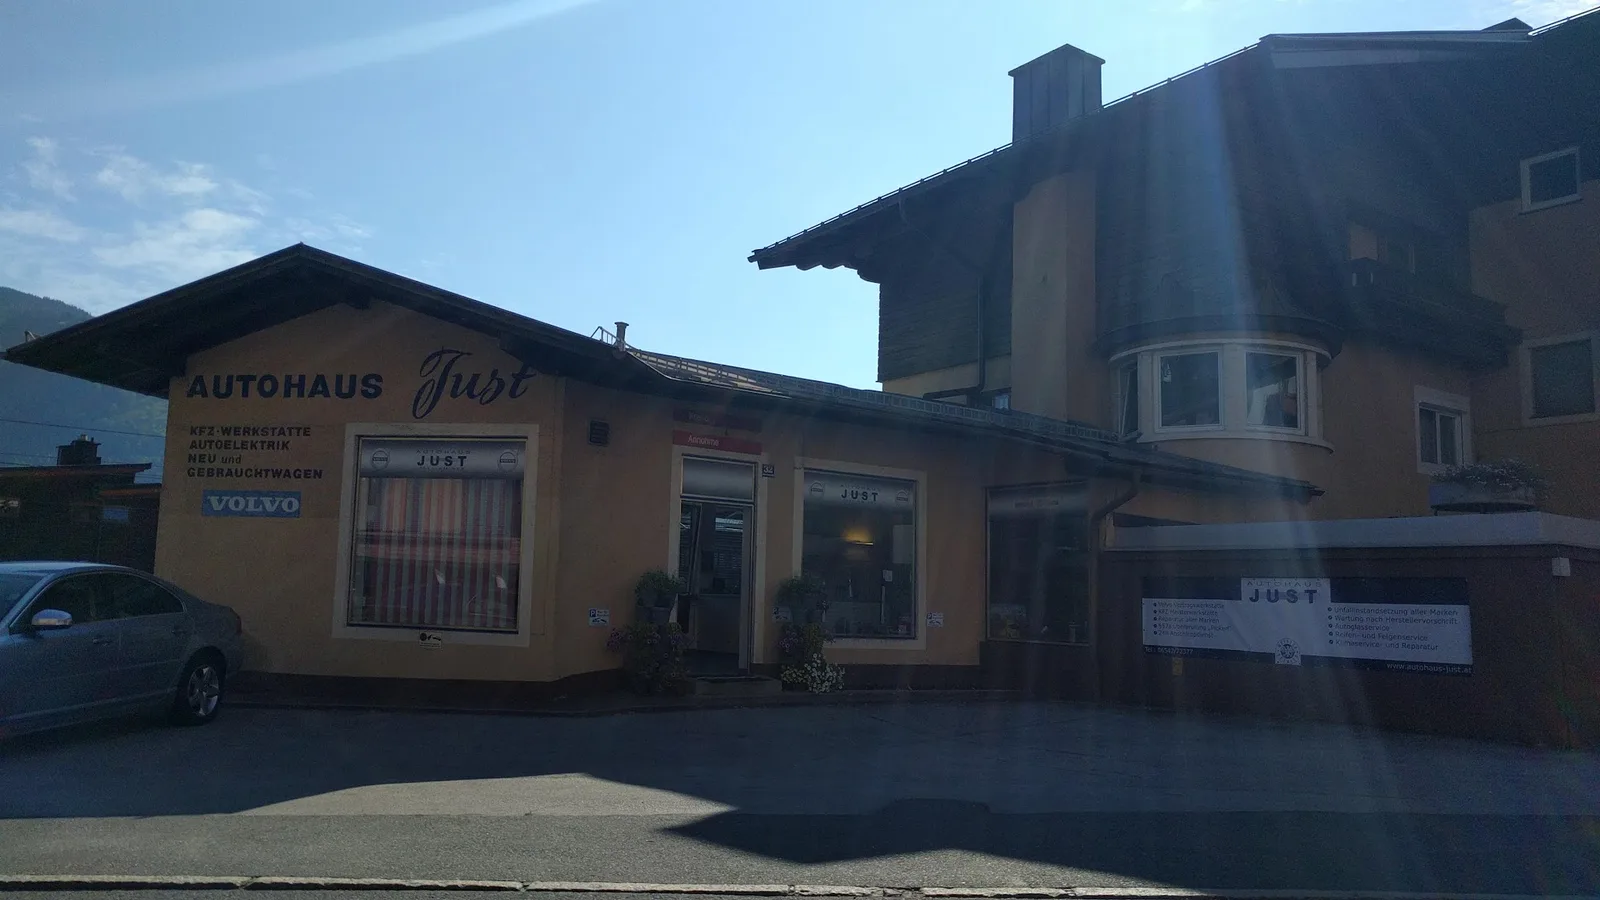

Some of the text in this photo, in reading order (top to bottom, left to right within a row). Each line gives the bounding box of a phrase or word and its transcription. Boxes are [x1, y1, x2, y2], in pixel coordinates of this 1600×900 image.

[186, 346, 536, 419] AUTOHAUS Just
[189, 439, 291, 450] AUTOELEKTRIK
[187, 453, 242, 464] NEU und
[417, 455, 467, 467] JUST
[187, 467, 323, 480] GEBRAUCHTWAGEN
[763, 465, 773, 474] 32
[841, 489, 879, 502] JUST
[207, 495, 300, 512] VOLVO
[1249, 588, 1317, 604] JUST
[1334, 607, 1458, 617] Unfallinstandsetzung aller Marken
[1335, 615, 1364, 623] Wartung
[1335, 623, 1390, 632] Autoglasservice
[1378, 632, 1428, 642] Felgenservice
[1385, 641, 1400, 649] und
[1402, 642, 1439, 651] Reparatur
[1386, 662, 1472, 674] www.autohaus-just.at
